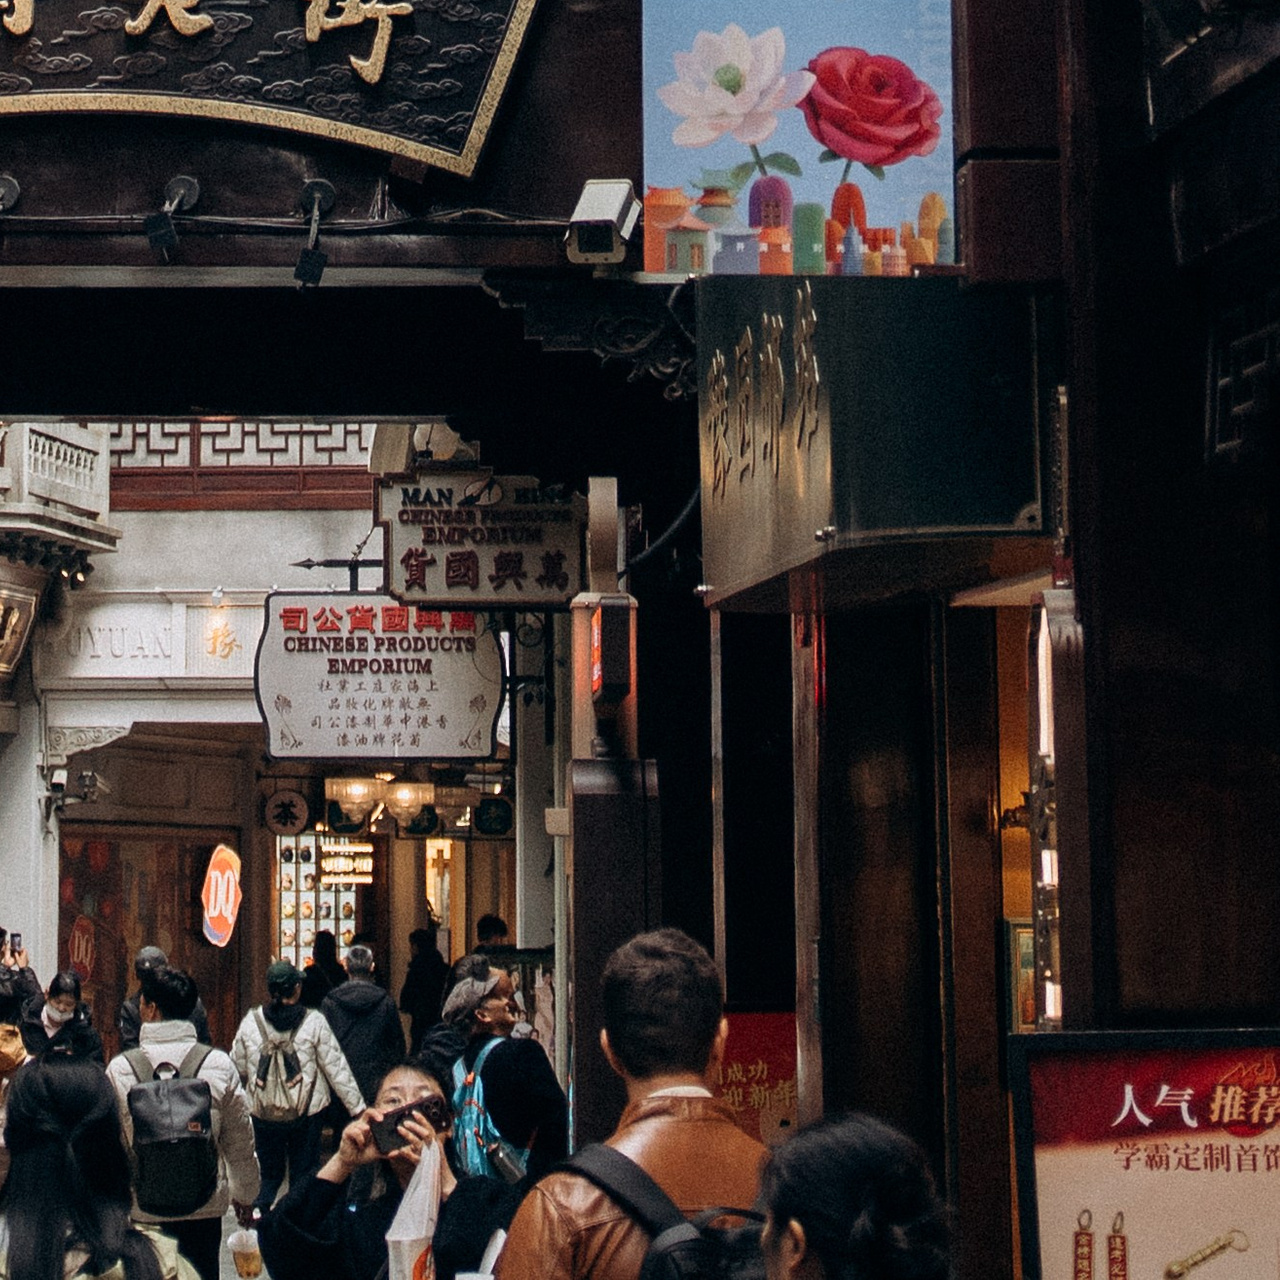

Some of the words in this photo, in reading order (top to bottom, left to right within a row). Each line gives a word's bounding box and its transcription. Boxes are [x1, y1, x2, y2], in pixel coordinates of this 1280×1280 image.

[401, 487, 453, 507] MAN
[398, 509, 475, 525] CHINESE
[422, 526, 543, 545] EMPORIUM
[283, 636, 369, 653] CHINESE
[374, 636, 477, 653] PRODUCTS
[327, 658, 433, 675] EMPORIUM
[208, 870, 236, 924] DQ
[717, 1060, 767, 1084] 成功
